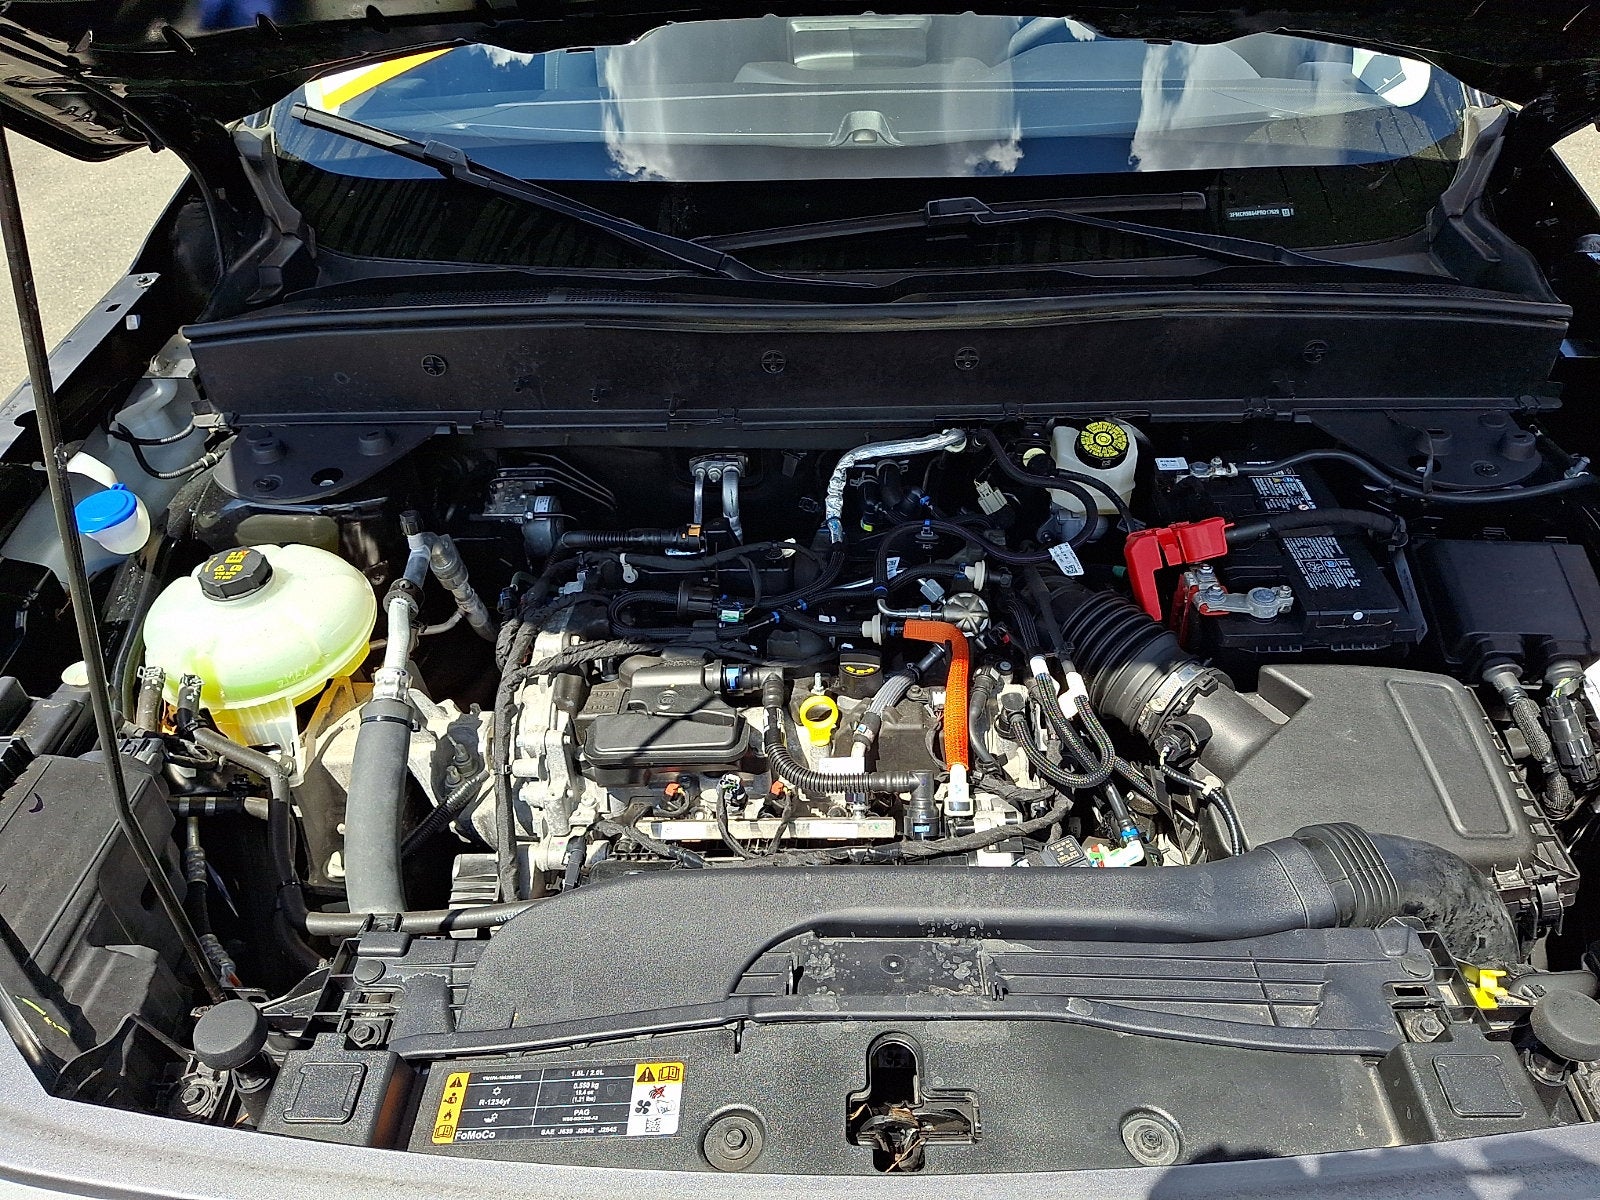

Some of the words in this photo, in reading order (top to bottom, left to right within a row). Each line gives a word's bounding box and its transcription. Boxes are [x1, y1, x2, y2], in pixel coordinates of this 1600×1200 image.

[591, 1081, 600, 1091] kg
[479, 1097, 511, 1107] R-1234yf
[455, 1130, 496, 1140] FoMoCo
